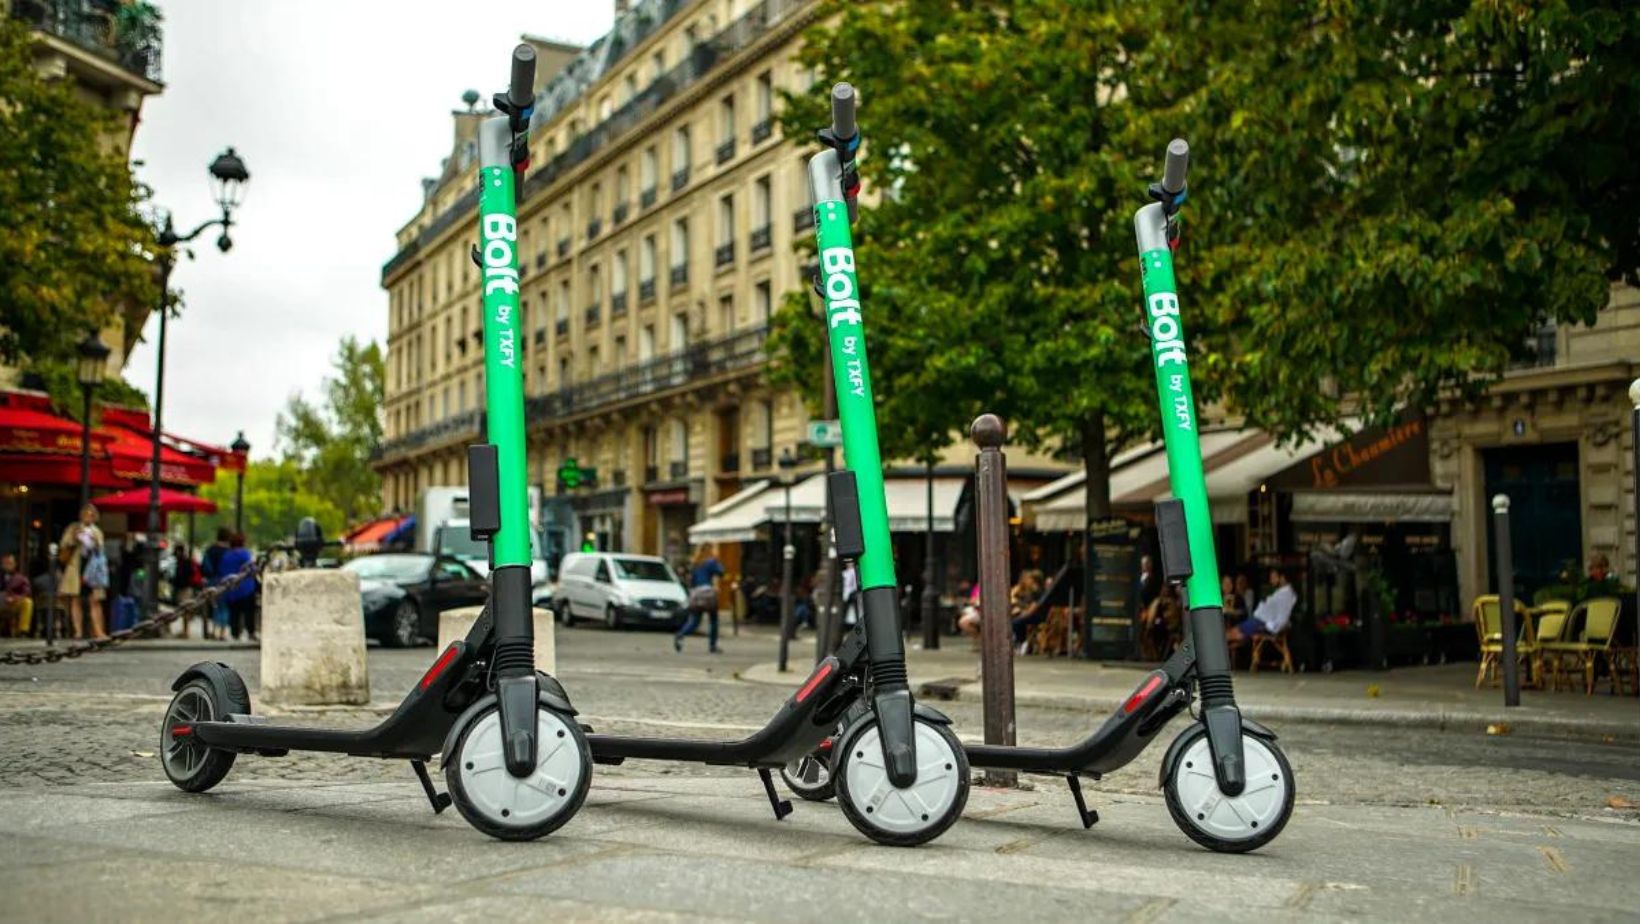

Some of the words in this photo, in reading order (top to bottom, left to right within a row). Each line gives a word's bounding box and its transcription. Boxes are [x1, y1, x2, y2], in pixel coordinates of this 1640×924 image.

[484, 213, 520, 296] Bolt
[822, 247, 862, 328] Bolt
[496, 305, 512, 326] by
[1149, 292, 1187, 367] Bolt
[499, 328, 514, 368] TXFY
[842, 336, 857, 356] by
[848, 358, 865, 397] TXFY
[1170, 374, 1182, 392] by
[1175, 395, 1190, 431] TXFY
